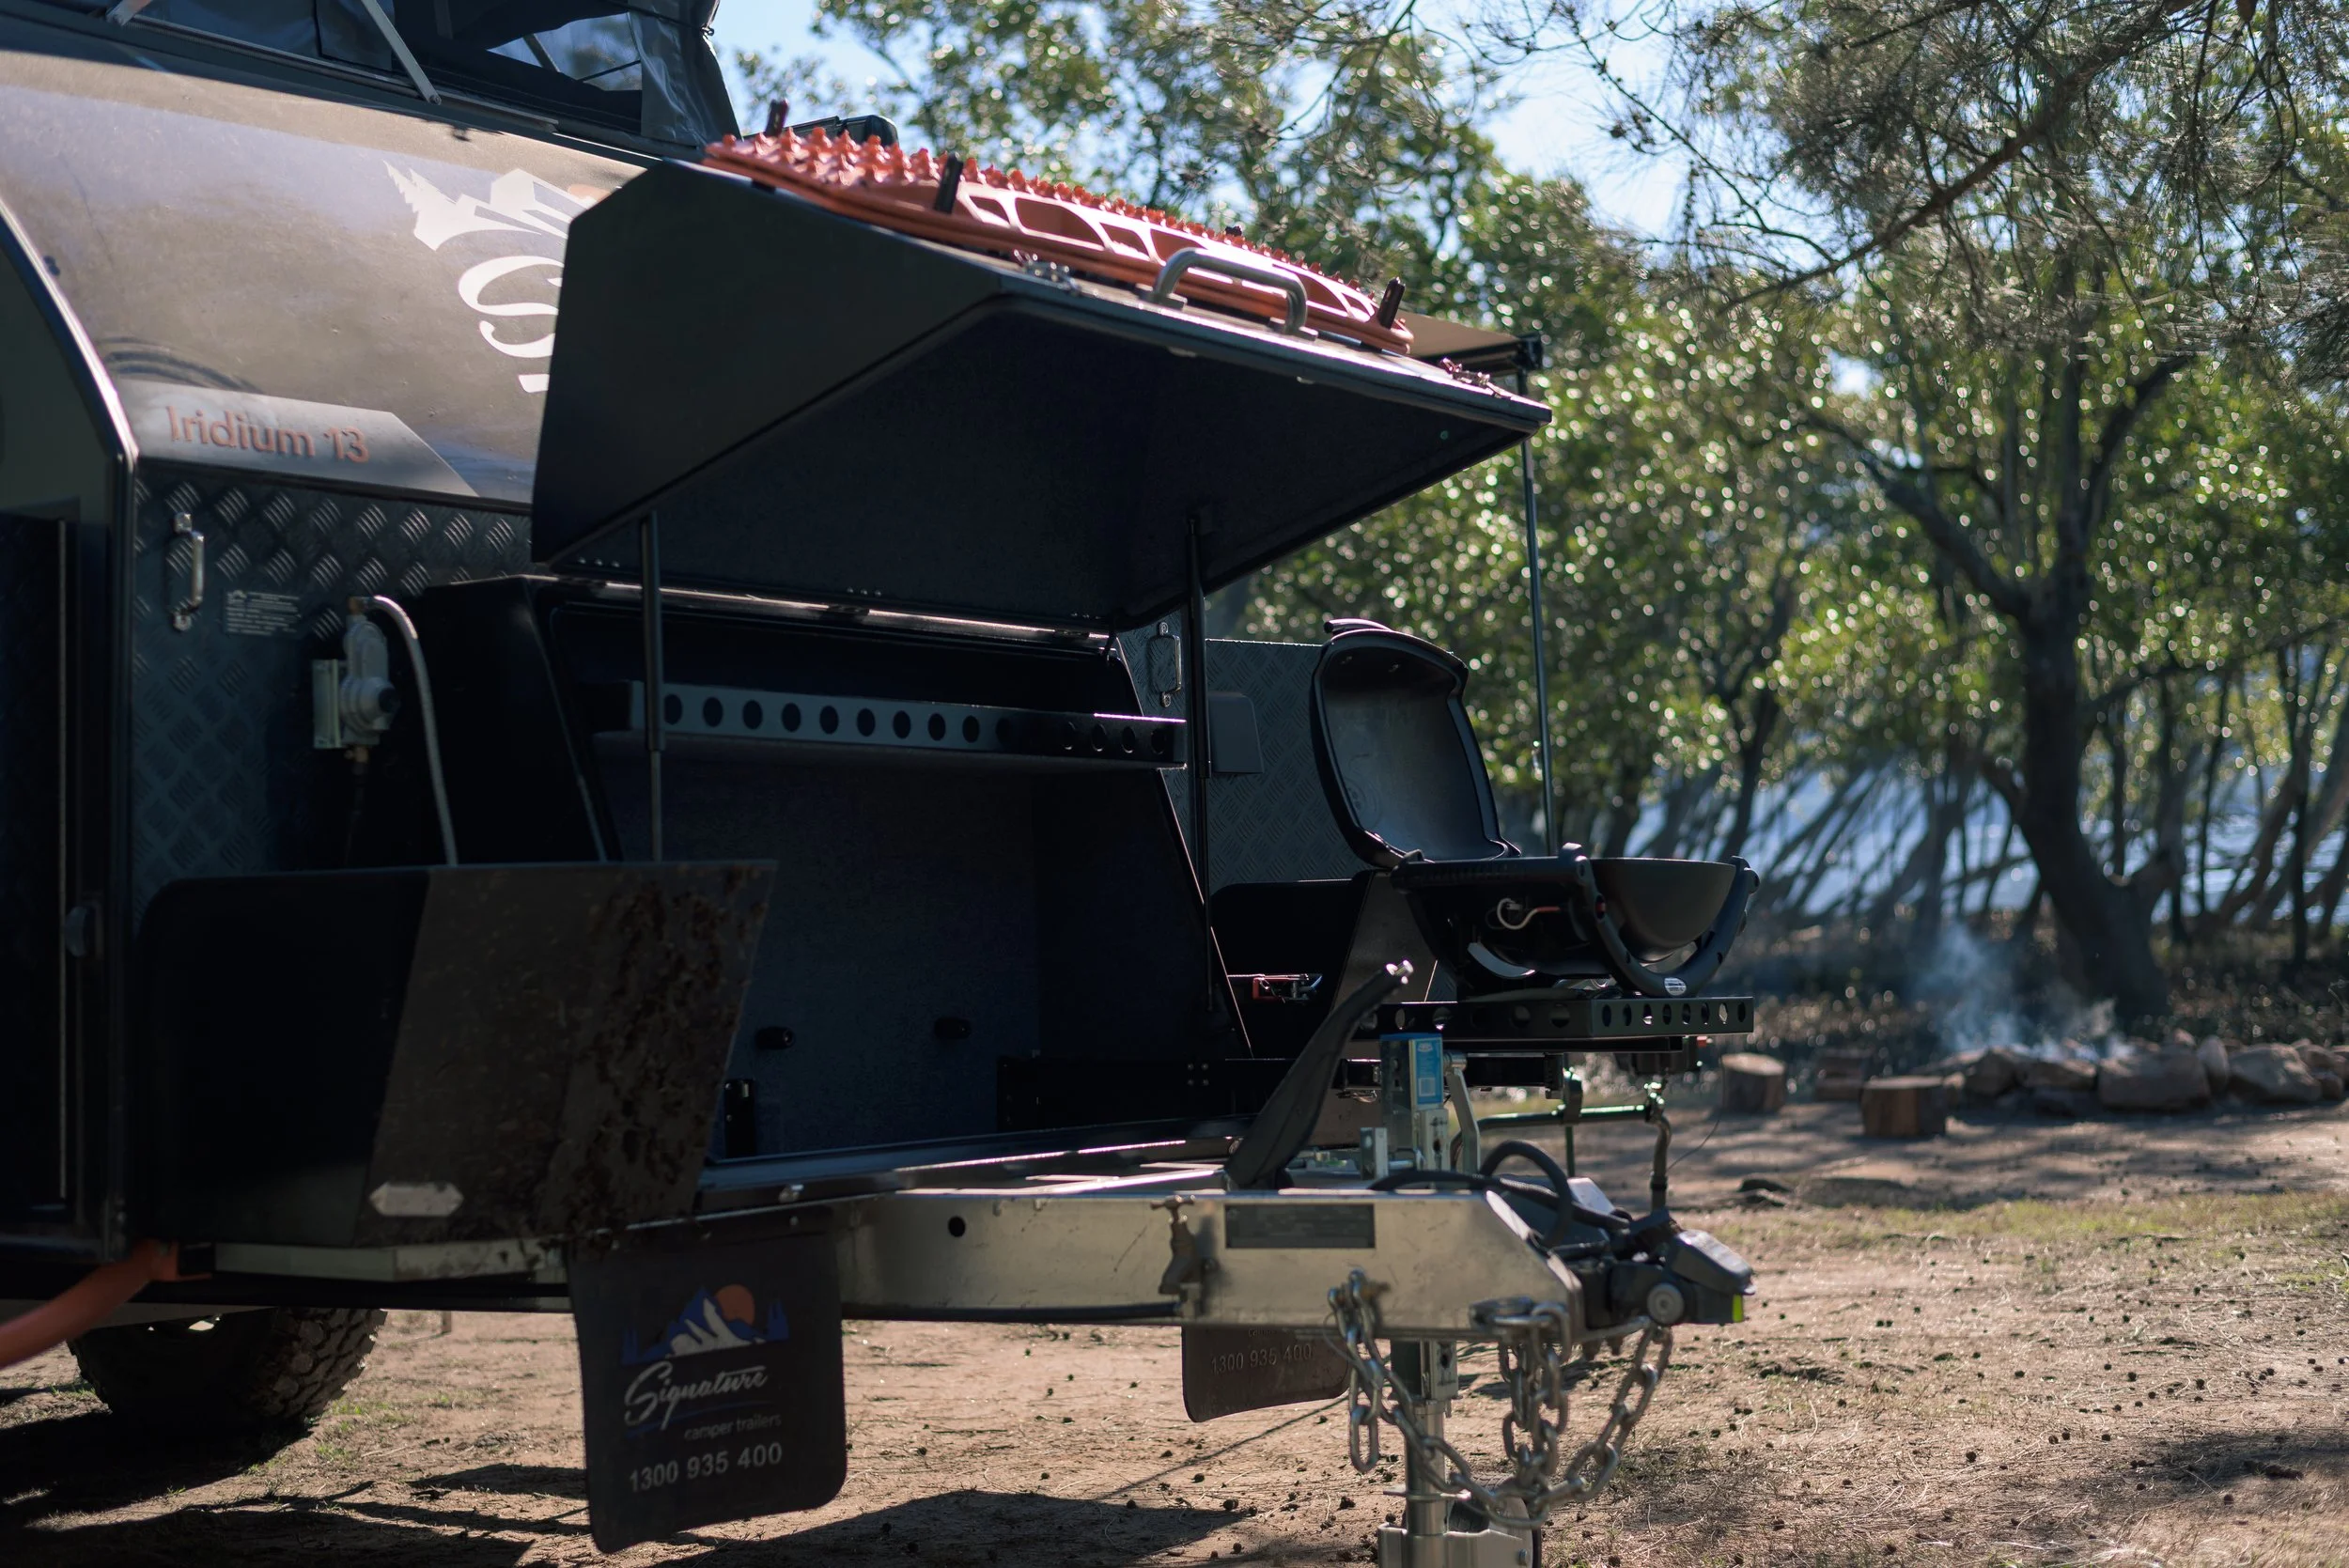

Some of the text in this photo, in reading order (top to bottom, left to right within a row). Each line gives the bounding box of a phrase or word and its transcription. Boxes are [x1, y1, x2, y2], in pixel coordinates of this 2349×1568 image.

[165, 405, 369, 463] Iridium 13
[1211, 1343, 1312, 1375] 1300 935 400
[624, 1360, 769, 1431] Signature
[684, 1413, 782, 1441] camper trailers
[630, 1442, 783, 1493] 1300 935 400
